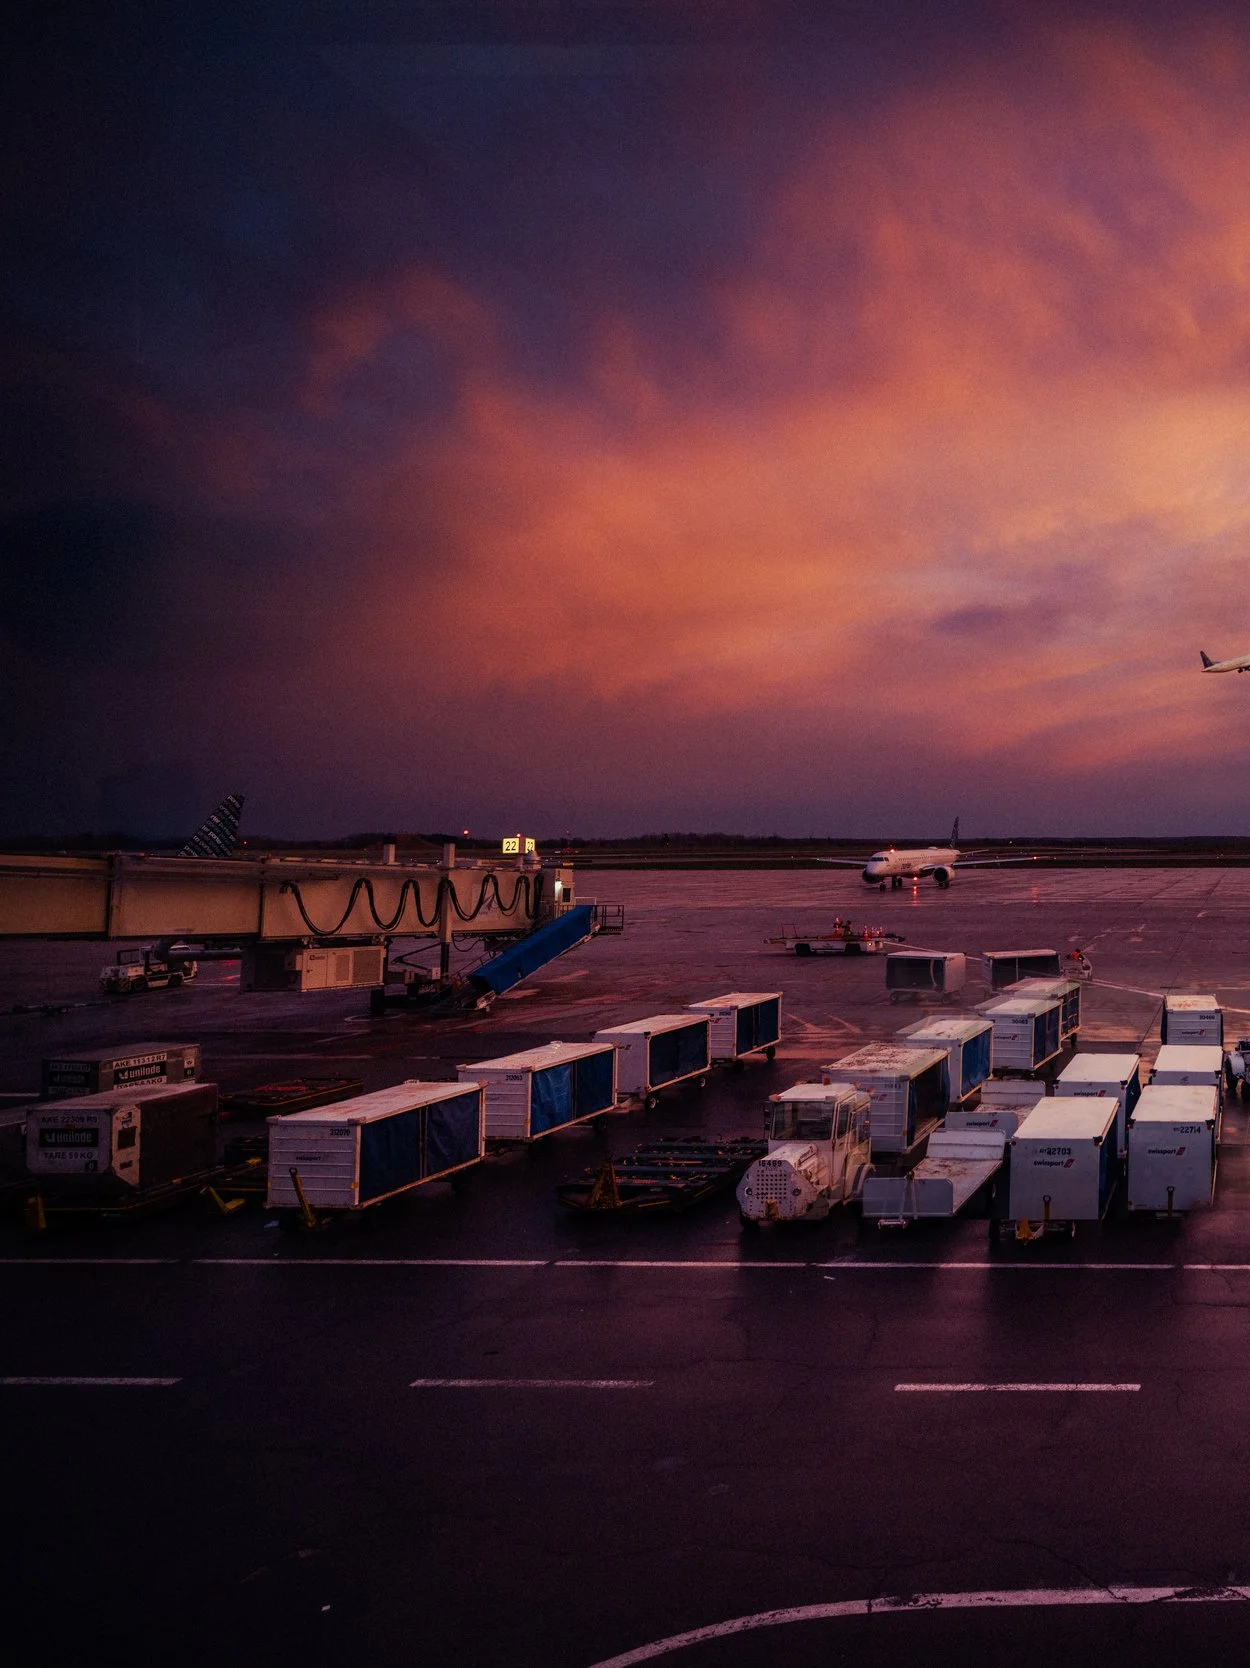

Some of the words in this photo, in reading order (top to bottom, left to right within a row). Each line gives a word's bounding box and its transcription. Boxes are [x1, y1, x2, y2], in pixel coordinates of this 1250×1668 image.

[505, 841, 516, 851] 22
[129, 1065, 161, 1079] unilode
[56, 1131, 93, 1144] unilode
[1034, 1159, 1064, 1168] swissport
